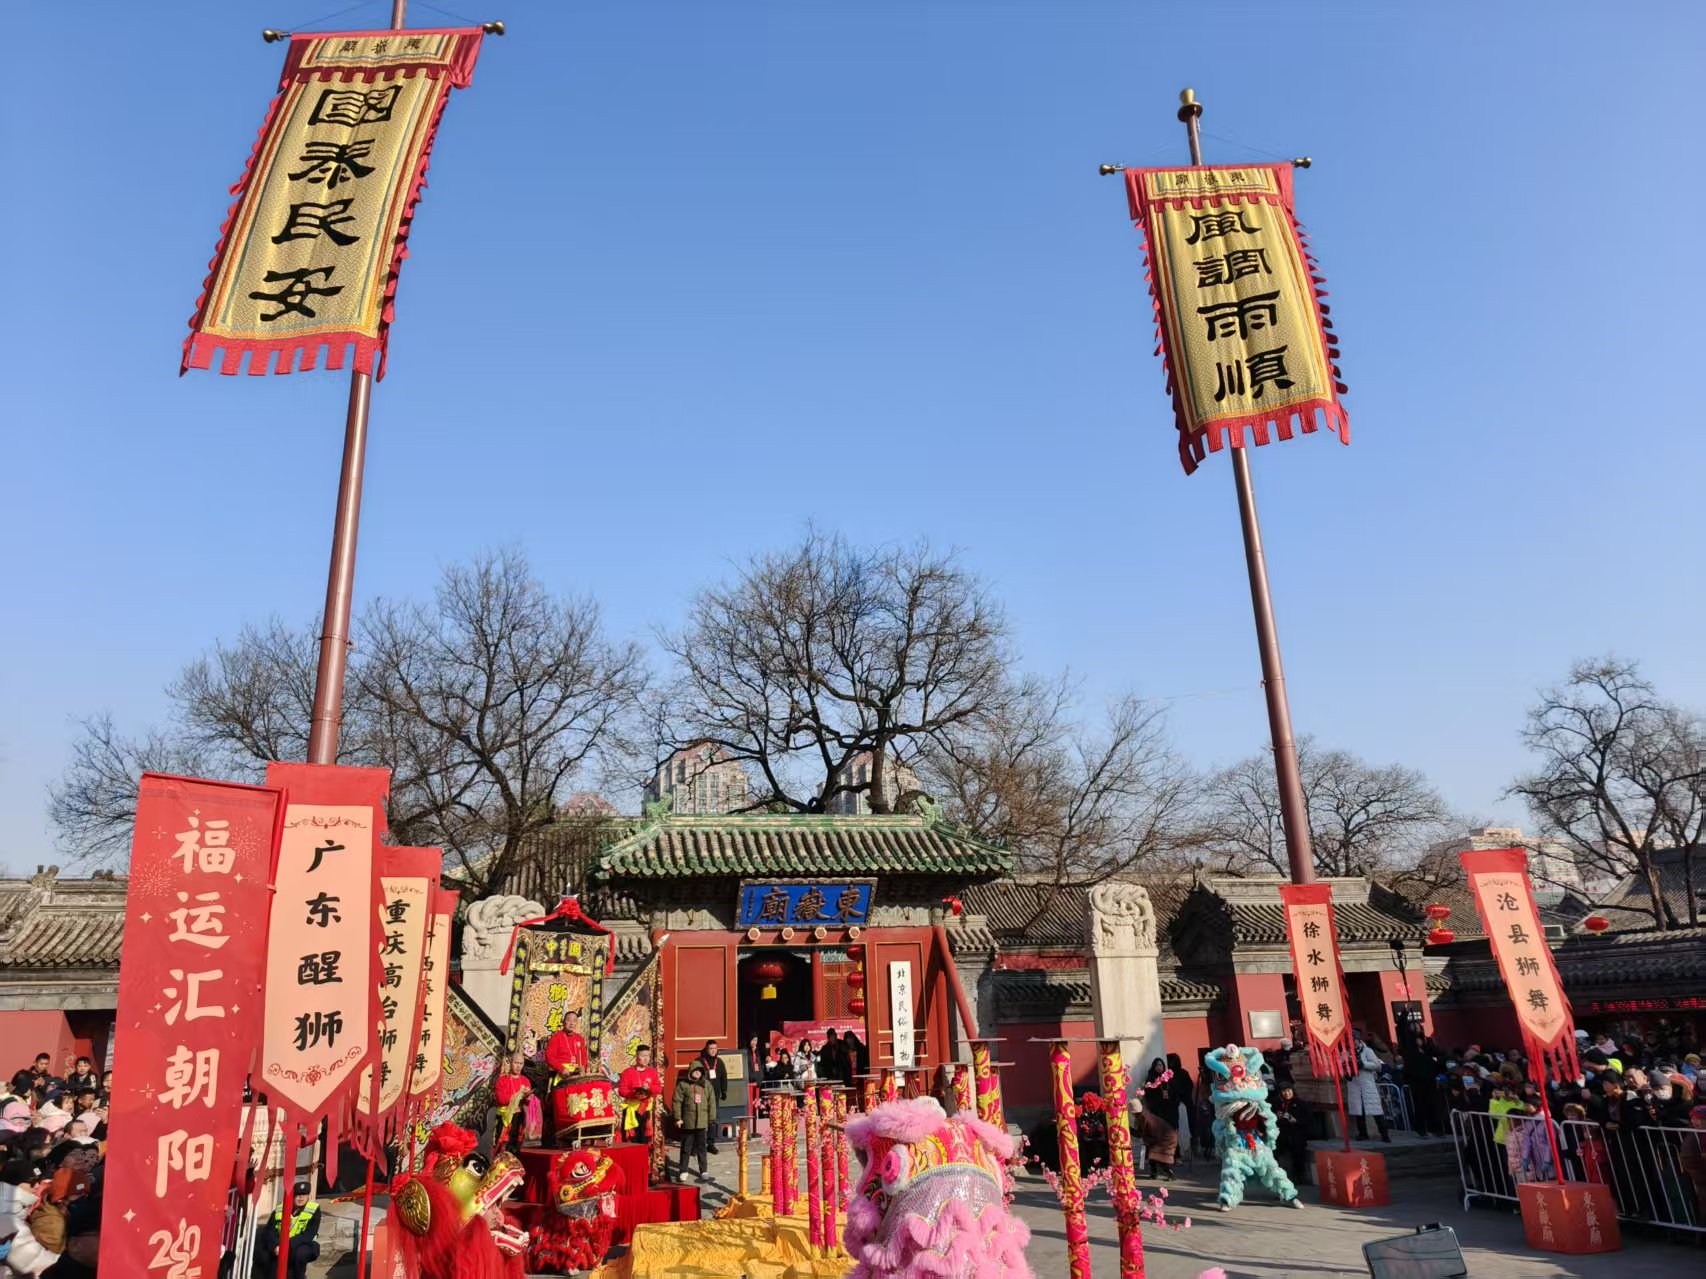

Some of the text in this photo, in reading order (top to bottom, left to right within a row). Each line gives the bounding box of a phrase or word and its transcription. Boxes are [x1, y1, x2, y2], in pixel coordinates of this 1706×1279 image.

[248, 85, 403, 322] 國泰民安
[1185, 210, 1296, 402] 風調雨順
[156, 816, 236, 1198] 福运汇朝阳
[292, 839, 346, 1051] 广东醒狮
[368, 898, 411, 1089] 重庆高台狮舞
[897, 967, 910, 1077] 北京民俗博物
[1303, 921, 1333, 1022] 徐水狮舞
[1496, 892, 1549, 1013] 沧县狮舞
